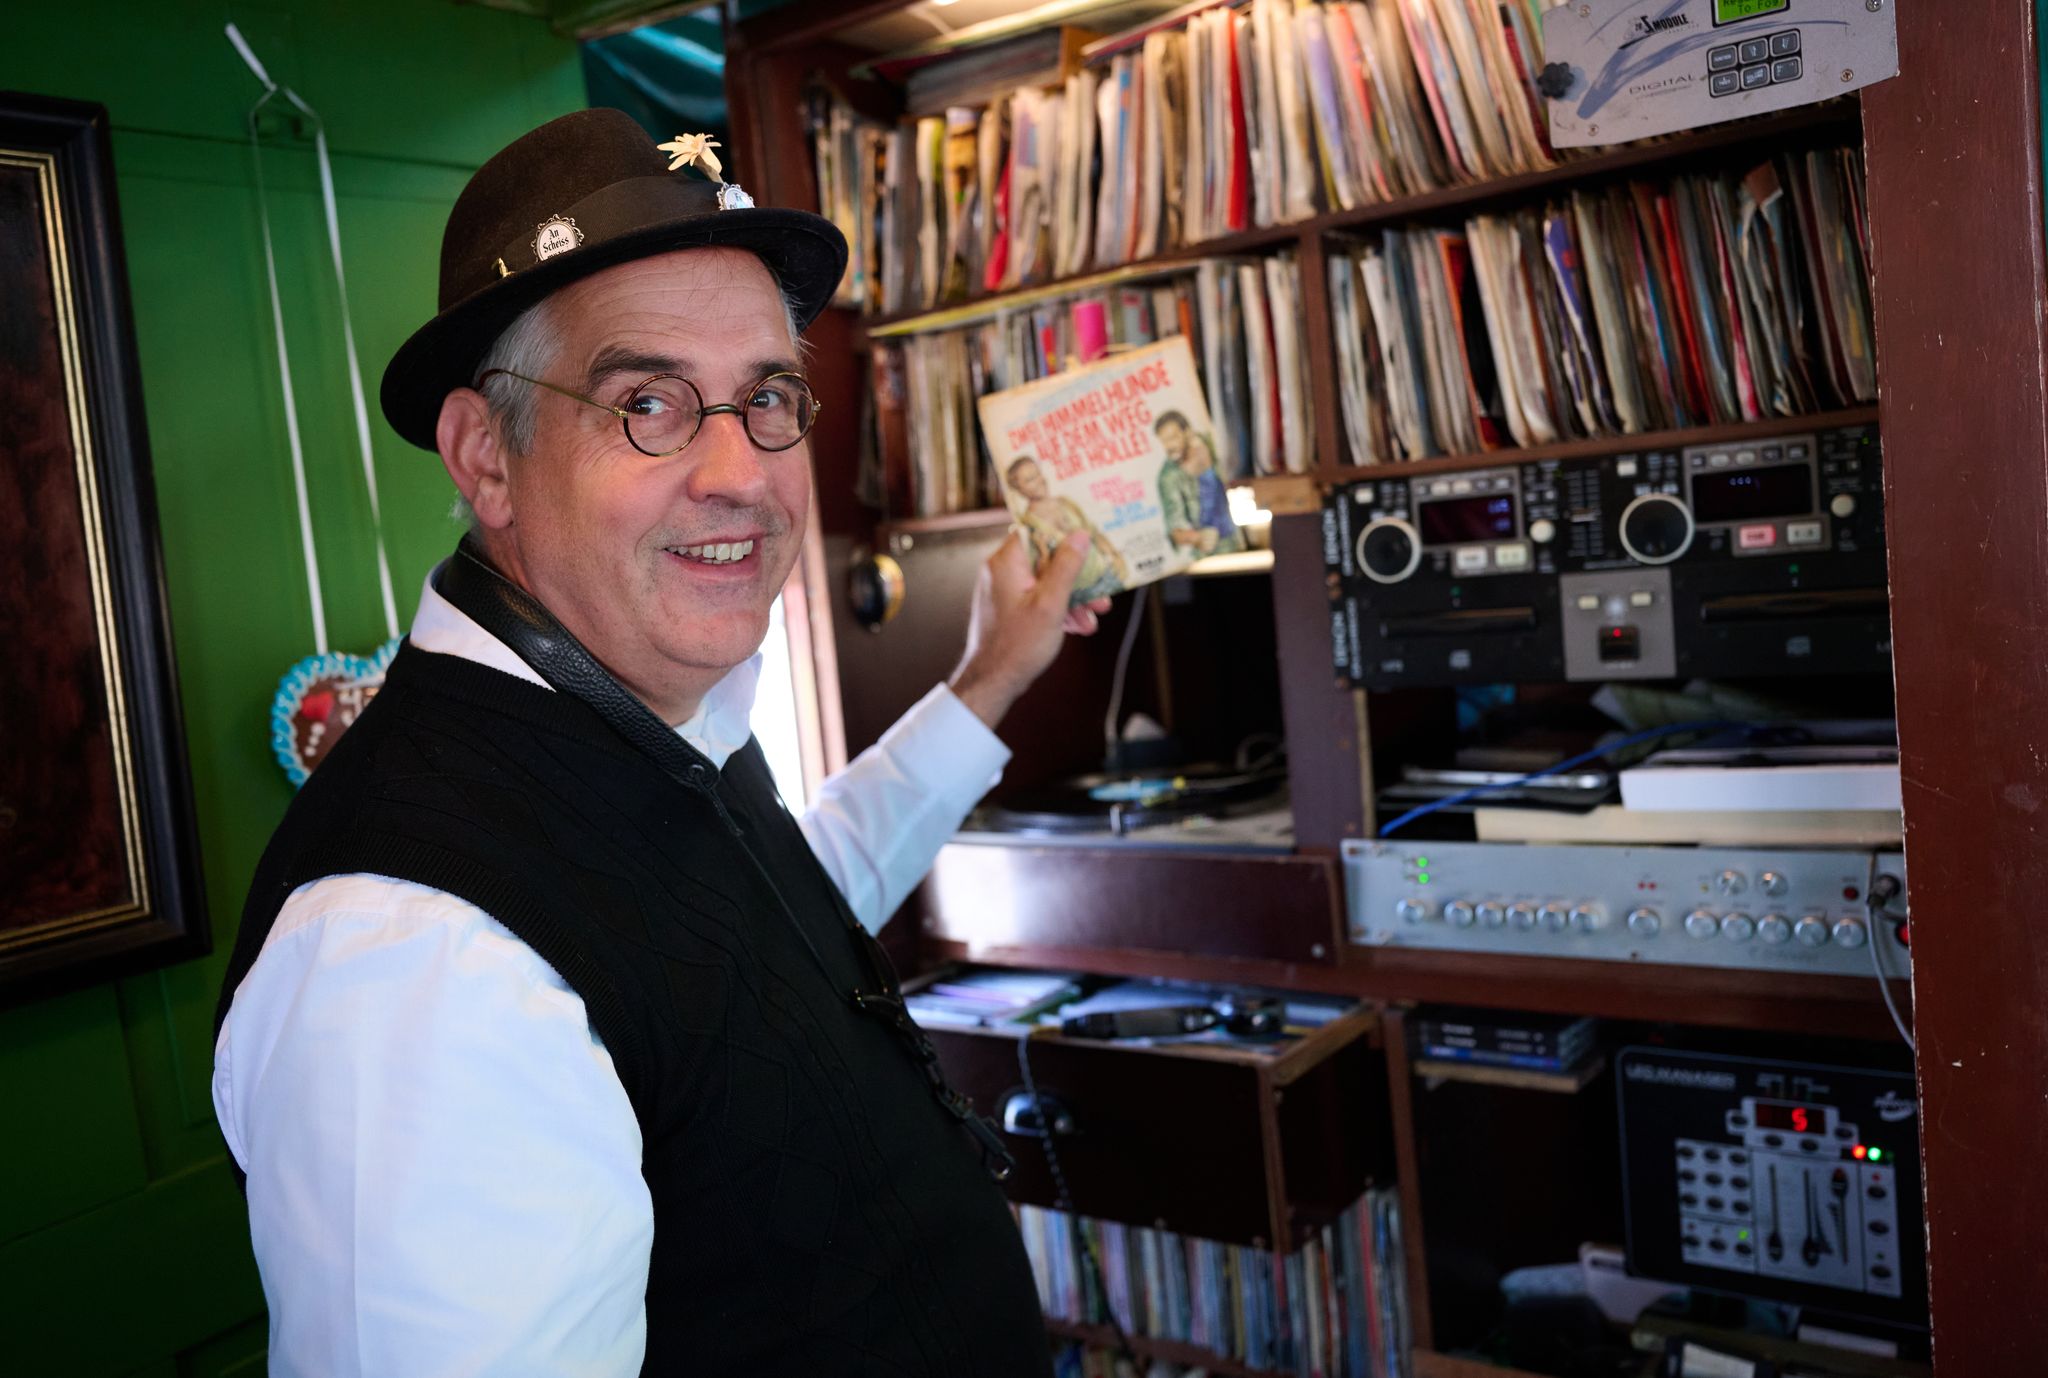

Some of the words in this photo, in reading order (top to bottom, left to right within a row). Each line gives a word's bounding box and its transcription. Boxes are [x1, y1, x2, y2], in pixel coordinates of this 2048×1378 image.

[1629, 73, 1696, 95] DIGITAL
[542, 236, 570, 254] Scheiss
[548, 229, 560, 239] An
[1038, 360, 1171, 433] HIMMELHUNDE
[1104, 398, 1153, 436] WEG
[1323, 508, 1340, 564] DENON
[1332, 611, 1348, 667] DENON
